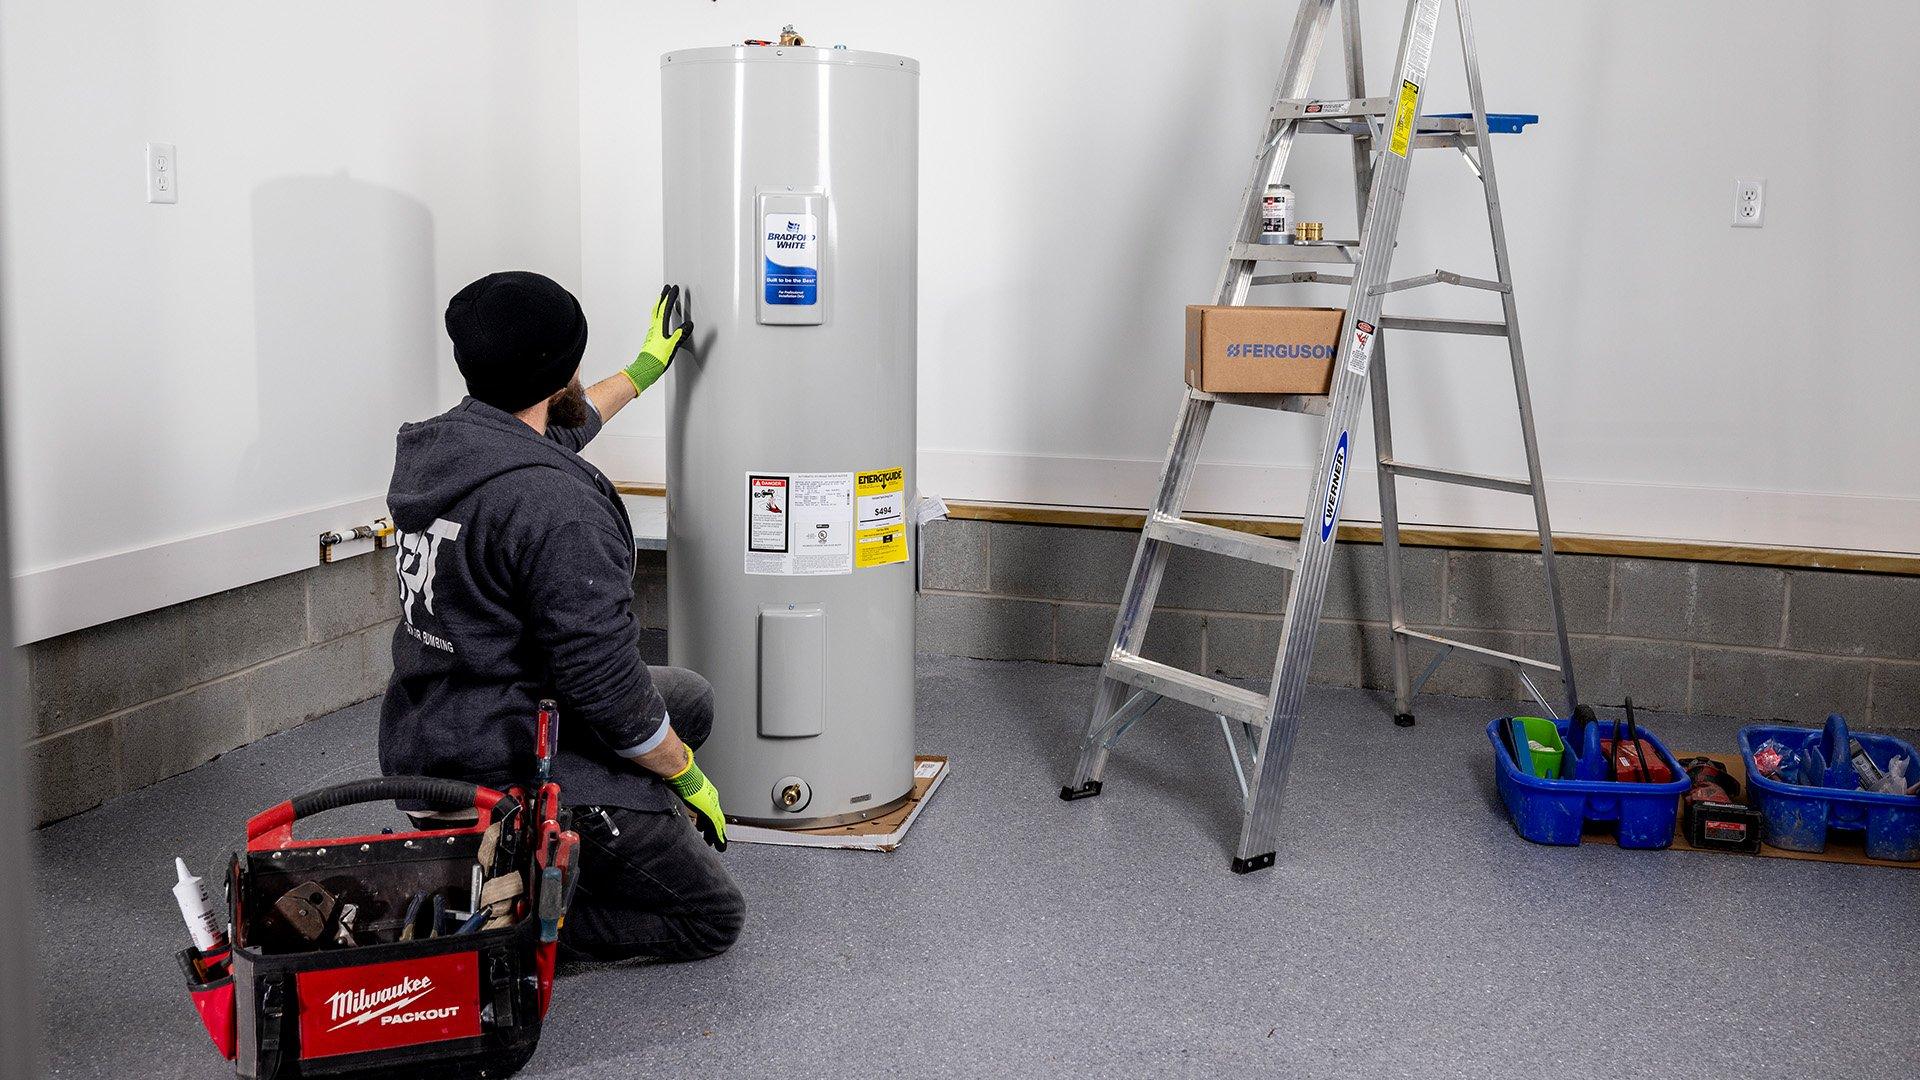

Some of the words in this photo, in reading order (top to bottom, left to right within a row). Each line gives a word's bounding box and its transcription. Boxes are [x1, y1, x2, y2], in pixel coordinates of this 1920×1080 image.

[767, 232, 816, 241] BRADFO
[776, 241, 806, 249] WHITE
[1243, 344, 1337, 360] FERGUSON
[1325, 452, 1344, 519] WERNER
[323, 975, 432, 1021] Milwaukee
[380, 1006, 460, 1026] PACKOUT
